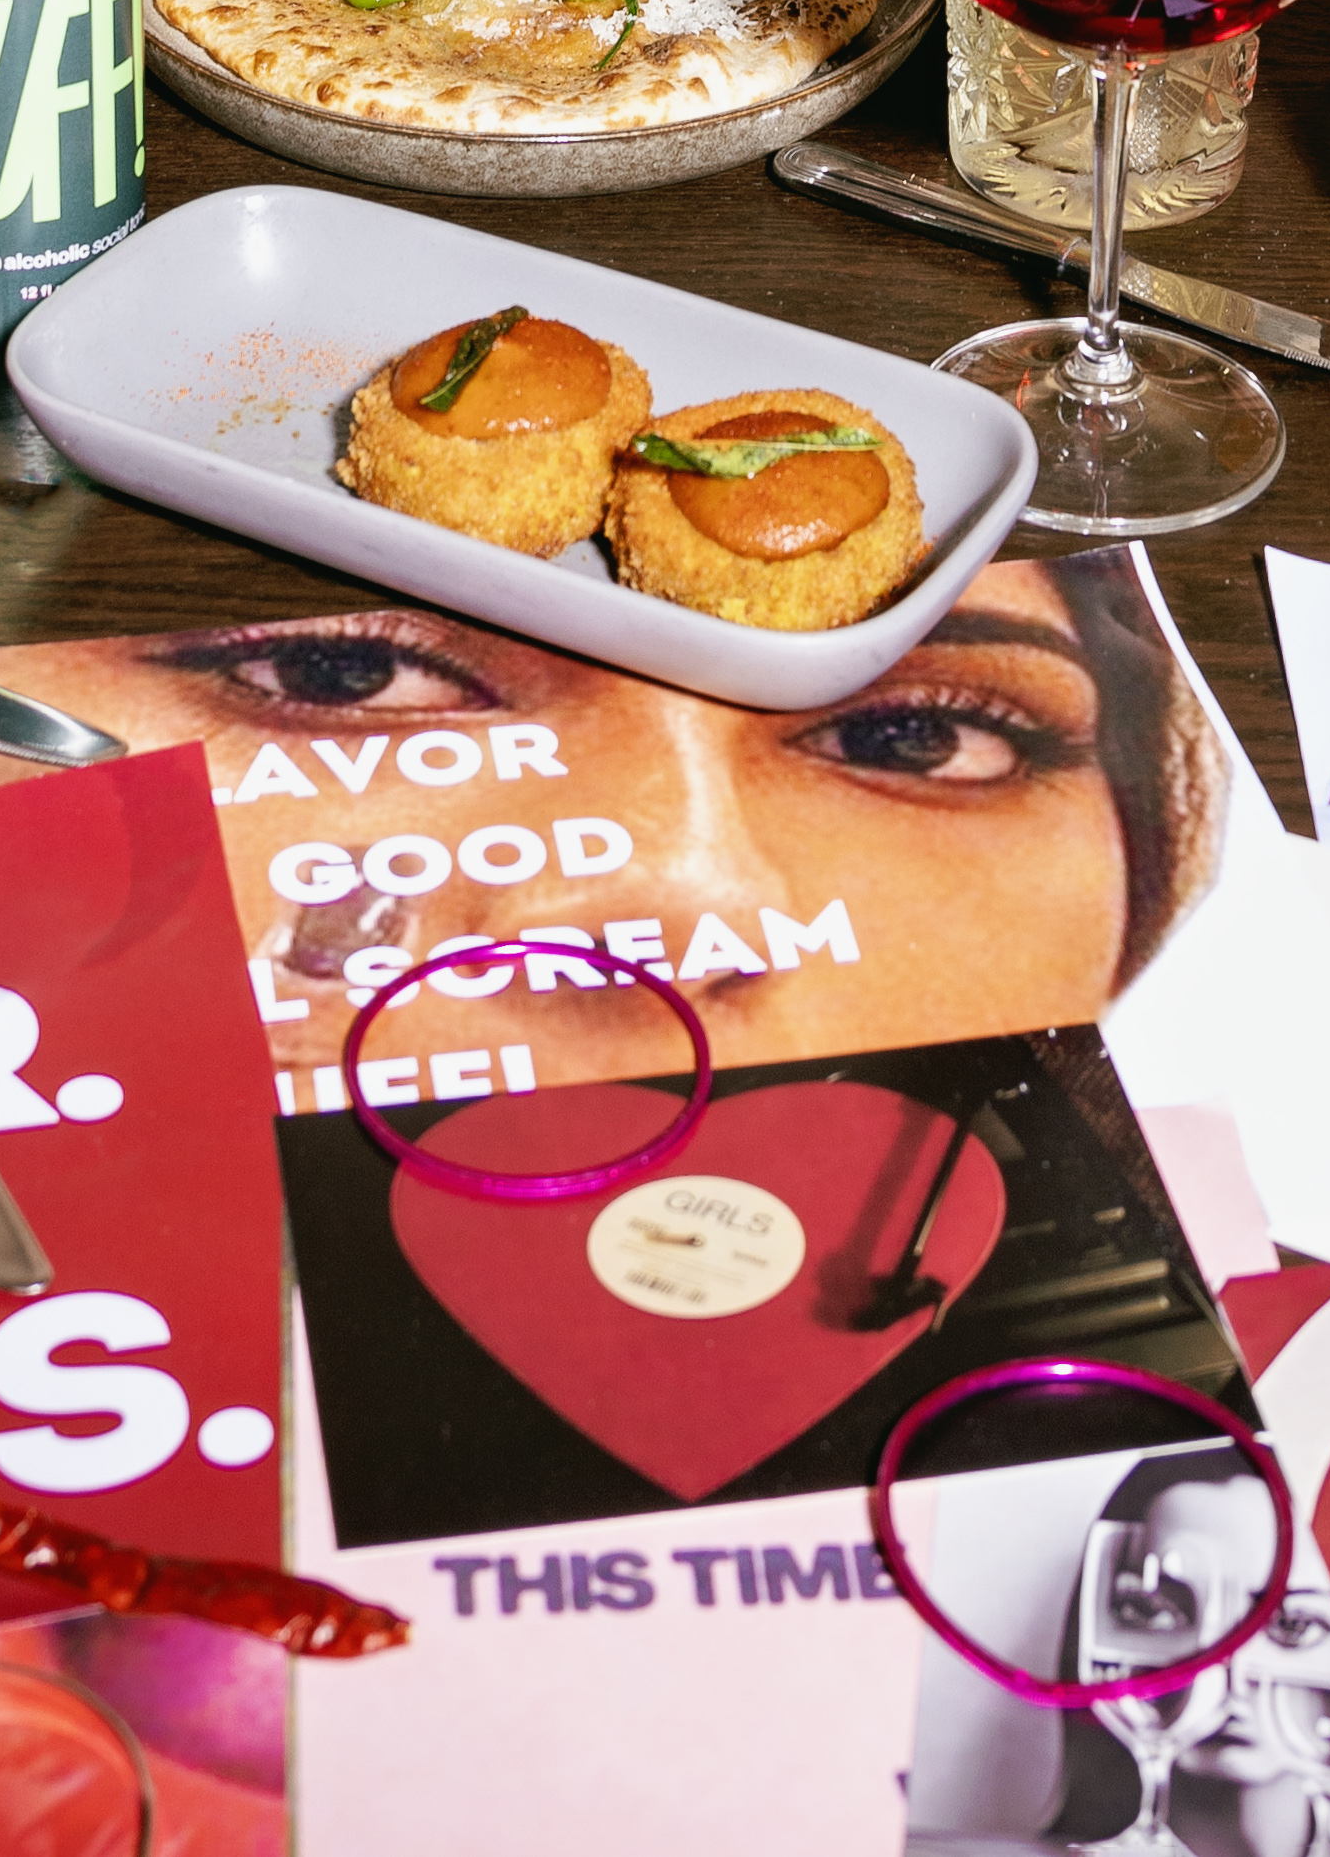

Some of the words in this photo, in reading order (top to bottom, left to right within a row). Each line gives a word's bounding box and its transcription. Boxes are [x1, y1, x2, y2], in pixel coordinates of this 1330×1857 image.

[3, 243, 90, 271] alcoholic
[91, 219, 129, 255] social
[20, 285, 38, 300] 12
[40, 284, 53, 299] fl
[211, 723, 569, 806] AVOR
[269, 817, 634, 906] GOOD
[249, 958, 309, 1023] L
[342, 898, 861, 1010] SCREAM
[664, 1189, 775, 1237] GIRLS
[433, 1549, 655, 1616] THIS
